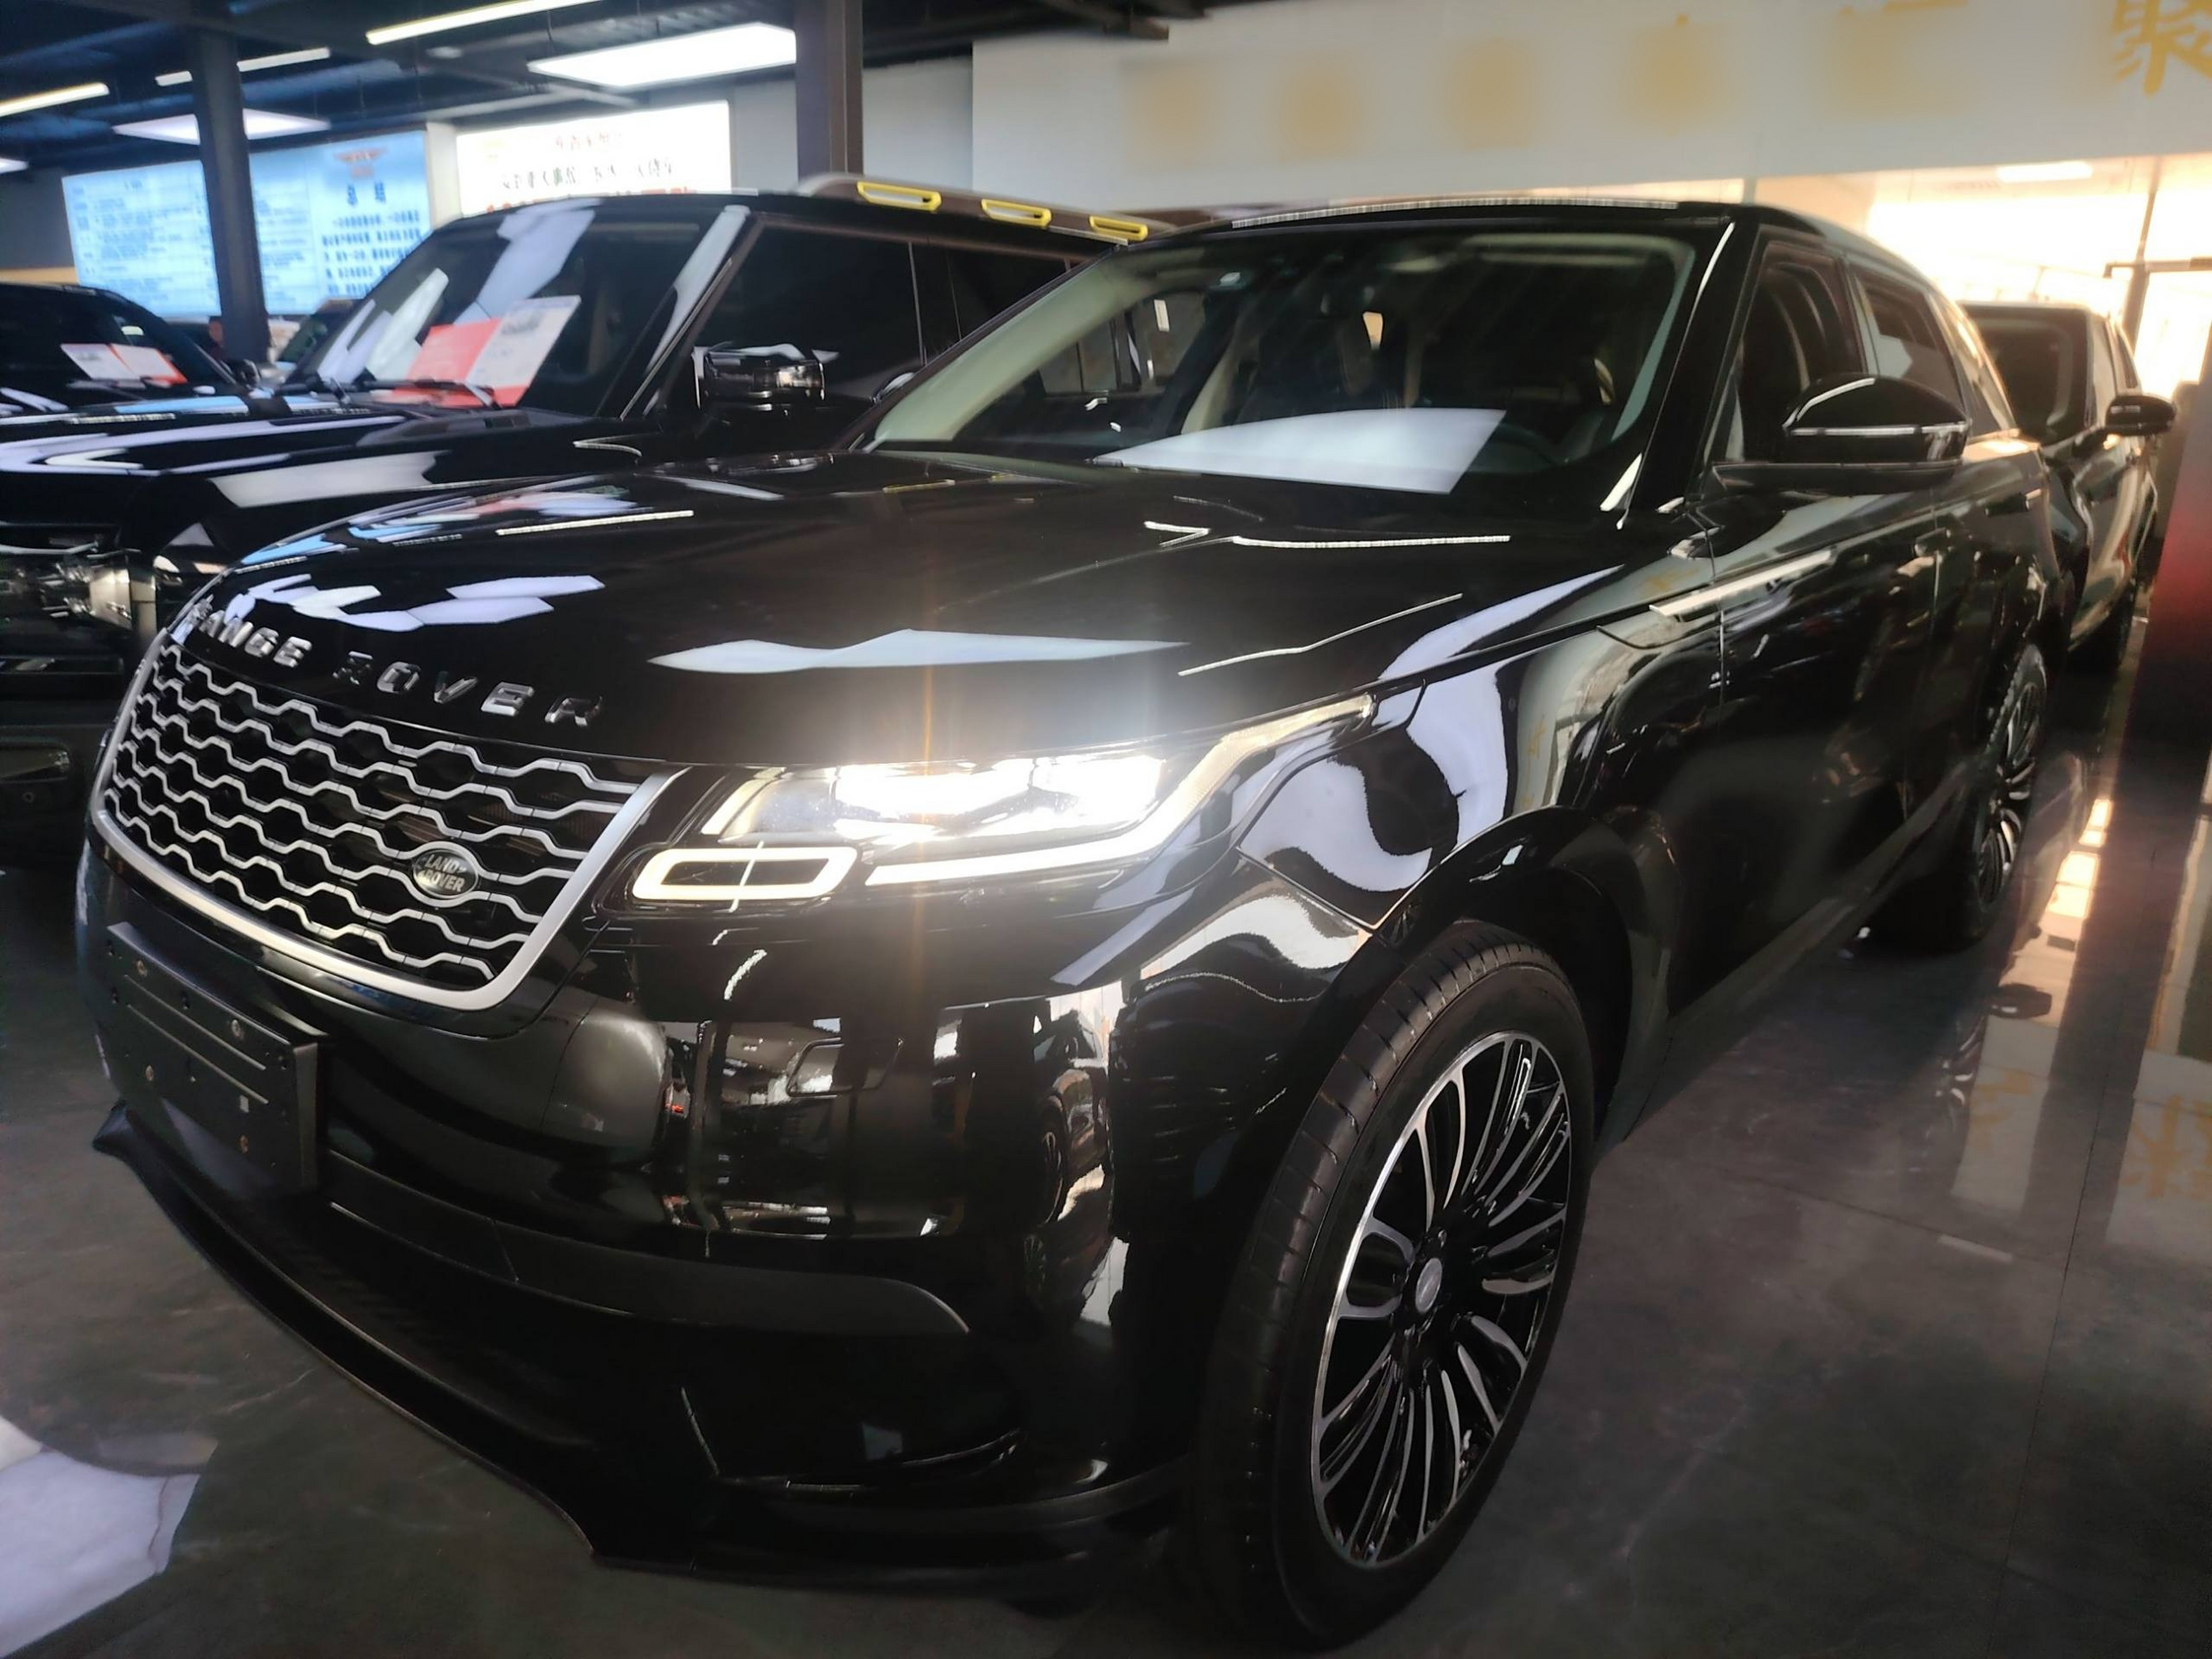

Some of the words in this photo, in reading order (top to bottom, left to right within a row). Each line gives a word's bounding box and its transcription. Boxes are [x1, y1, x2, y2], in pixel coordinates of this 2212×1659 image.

[332, 650, 603, 727] ROVER
[424, 854, 460, 874] LAND
[425, 870, 465, 893] ROVER
